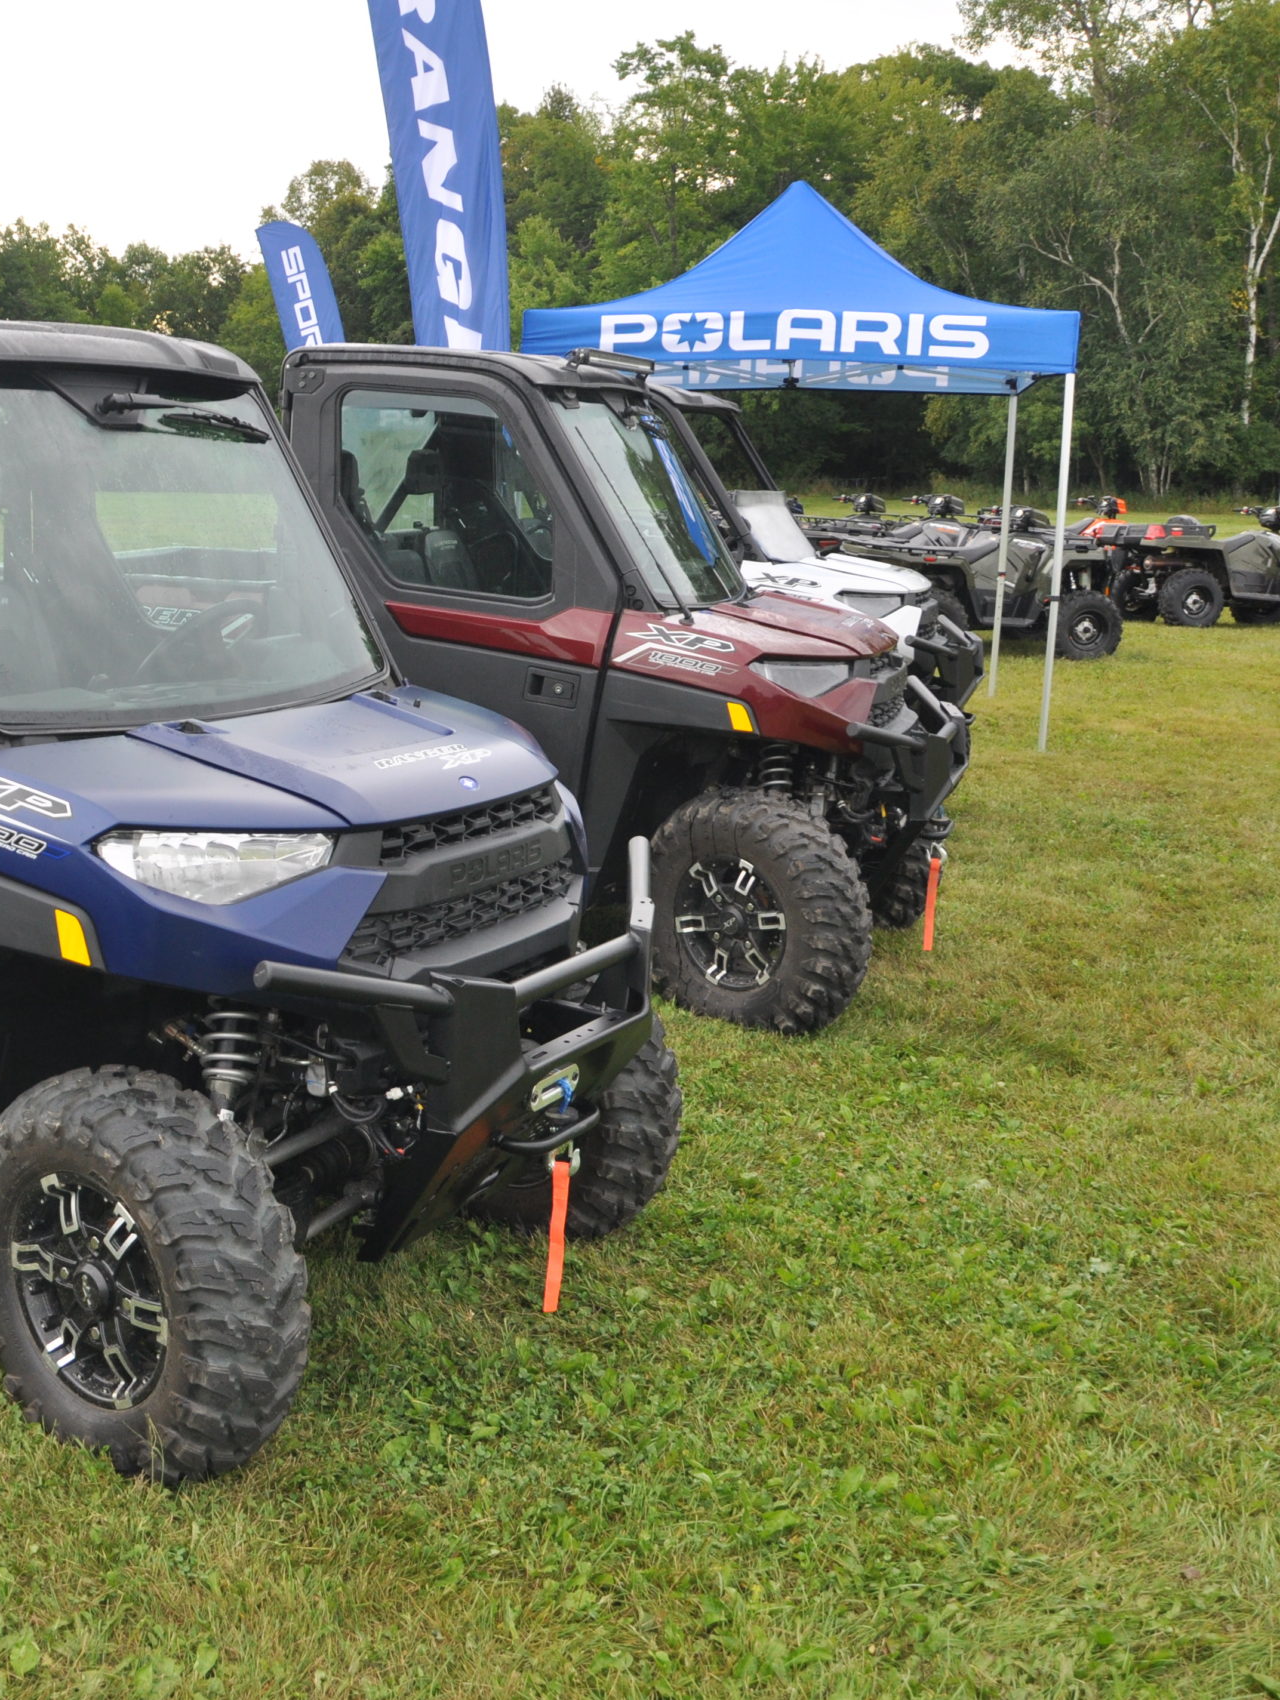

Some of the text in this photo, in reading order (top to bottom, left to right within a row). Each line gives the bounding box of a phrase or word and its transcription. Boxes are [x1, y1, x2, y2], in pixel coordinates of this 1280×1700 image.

[600, 308, 989, 359] POLARIS
[747, 572, 821, 588] XP
[625, 623, 735, 652] XP
[648, 650, 722, 673] 1000
[449, 839, 542, 892] POLARIS
